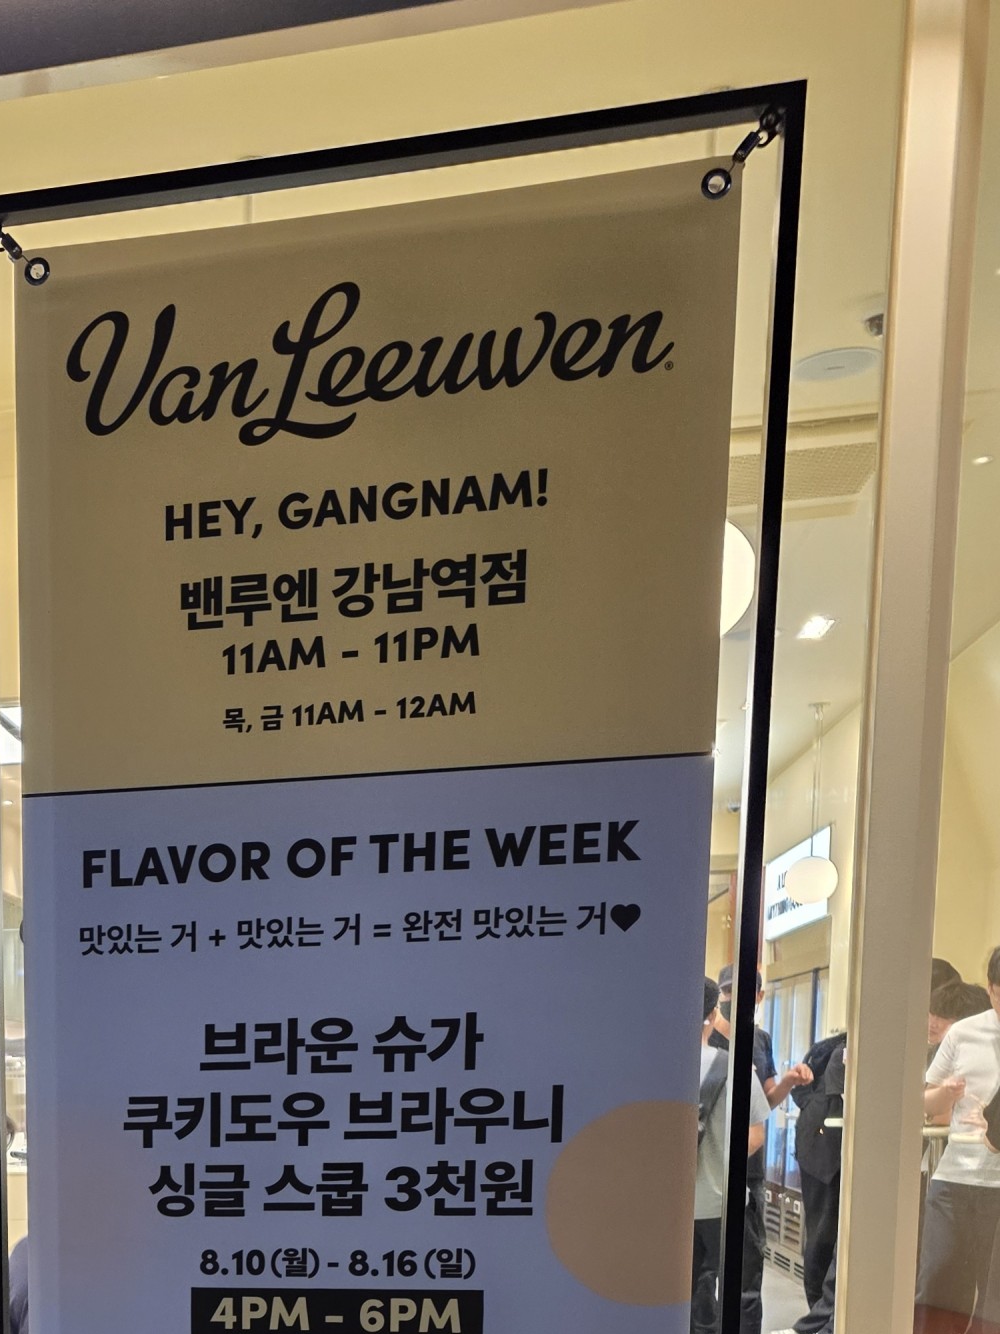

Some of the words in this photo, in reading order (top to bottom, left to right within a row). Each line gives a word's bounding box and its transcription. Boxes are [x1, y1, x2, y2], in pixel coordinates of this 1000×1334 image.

[166, 497, 262, 541] HEY,
[278, 468, 548, 529] GANGNAM!
[181, 568, 318, 630] 밴루엔
[332, 549, 527, 617] 강남역점
[223, 636, 325, 675] 11AM
[375, 624, 479, 663] 11PM
[223, 708, 252, 733] 목,
[261, 706, 283, 731] 금
[292, 700, 364, 726] 11AM
[397, 691, 476, 719] 12AM
[83, 842, 270, 888] FLAVOR
[287, 836, 356, 878] OF
[370, 830, 470, 873] THE
[485, 820, 641, 867] WEEK
[80, 924, 162, 955] 맛있는
[171, 921, 196, 952] 거
[238, 917, 324, 949] 맛있는
[333, 914, 360, 945] 거
[403, 909, 461, 942] 완전
[474, 905, 567, 939] 맛있는
[200, 1018, 358, 1075] 브라운
[373, 1012, 484, 1072] 슈가
[124, 1092, 330, 1148] 쿠키도우
[344, 1085, 564, 1144] 브라우니
[149, 1163, 249, 1217] 싱글
[264, 1162, 368, 1216] 스쿱
[385, 1159, 533, 1216] 3천원
[210, 1297, 309, 1331] 4PM
[359, 1298, 461, 1334] 6PM
